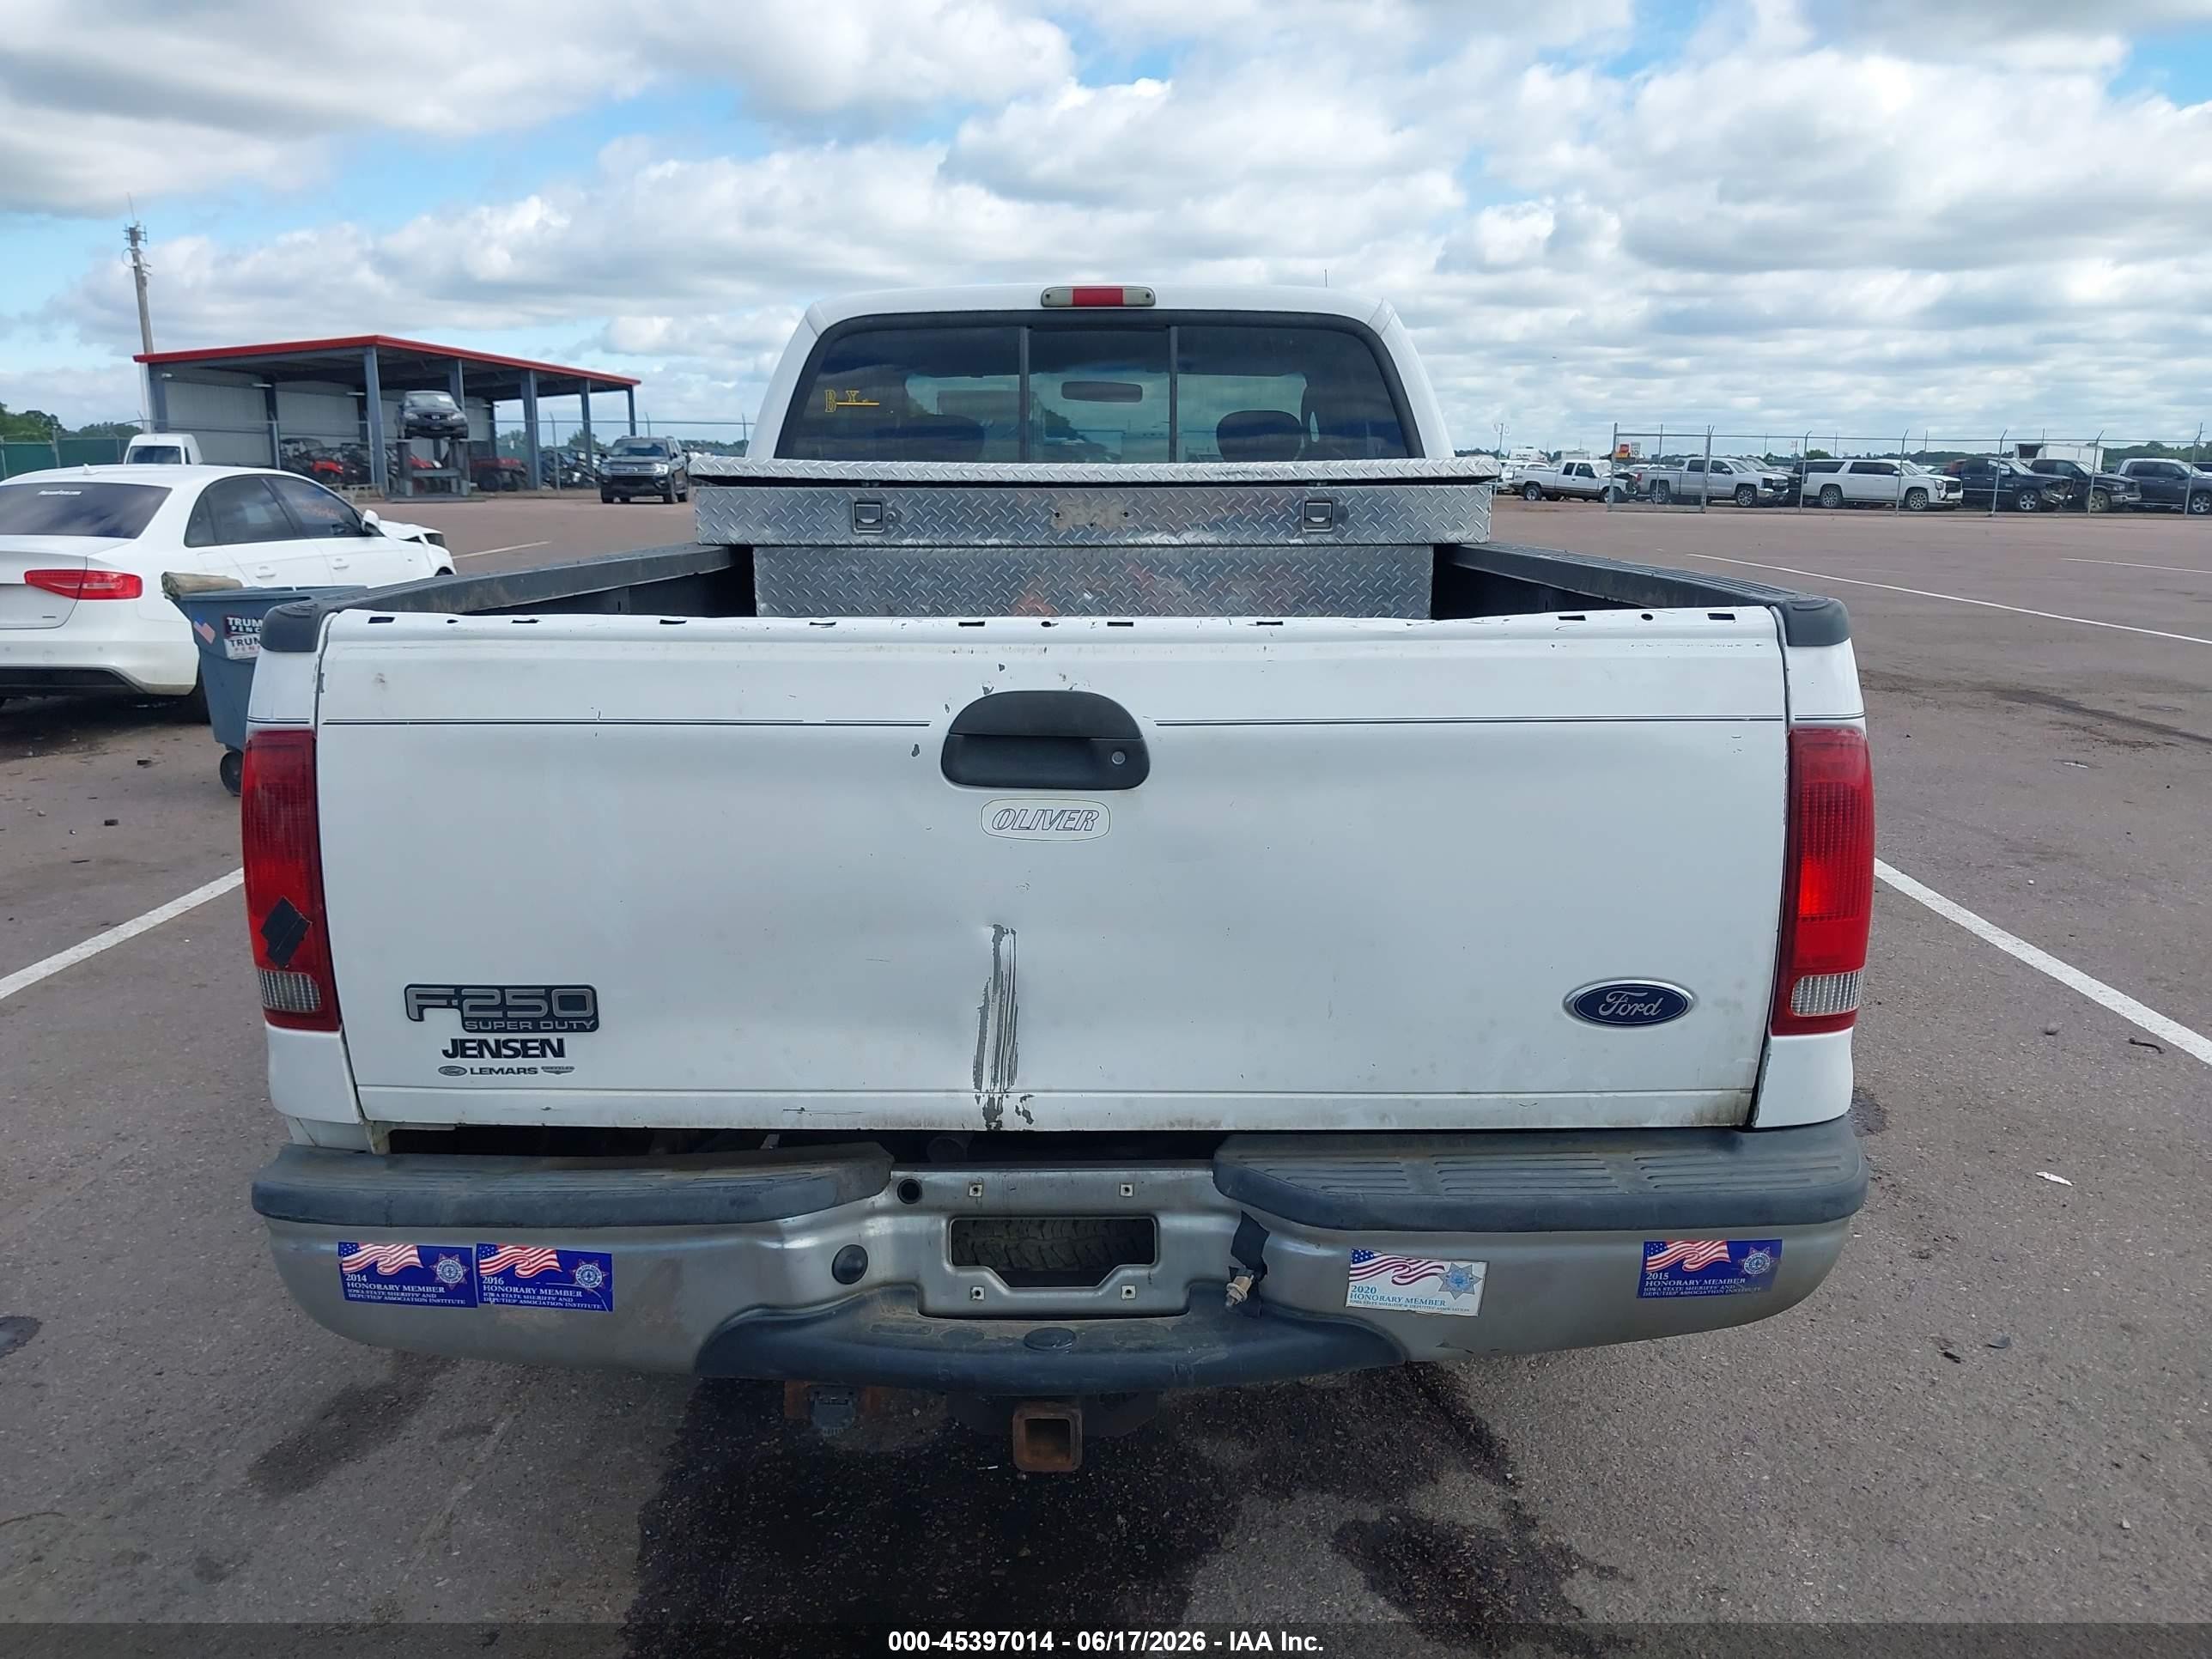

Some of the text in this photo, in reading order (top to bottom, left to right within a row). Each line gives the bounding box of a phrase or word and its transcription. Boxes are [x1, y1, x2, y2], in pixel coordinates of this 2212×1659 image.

[227, 617, 263, 627] TRUM
[992, 808, 1100, 831] OLIVER
[1598, 991, 1664, 1017] Ford
[465, 1020, 596, 1030] SUPER DUTY
[441, 1038, 566, 1059] JENSEN
[345, 1273, 367, 1282] 2014
[483, 1276, 504, 1285] 2016
[347, 1282, 445, 1293] HONORARY MEMBER
[483, 1285, 537, 1294] HONORARY
[1351, 1285, 1376, 1294] 2020
[1350, 1292, 1446, 1306] HONORARY MEMBER
